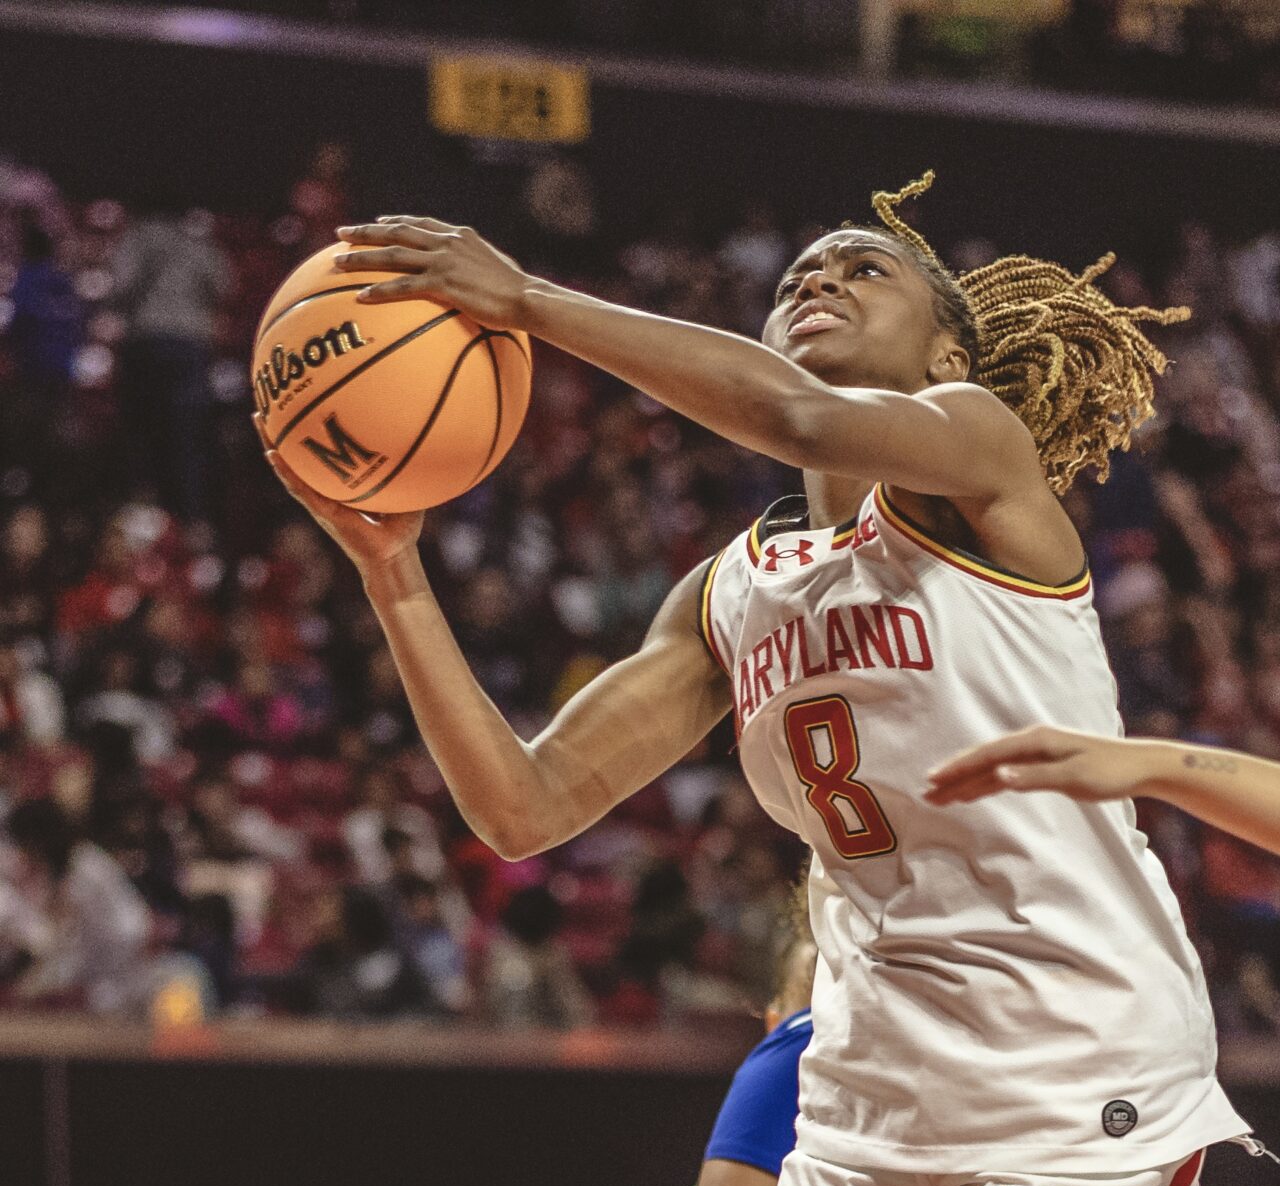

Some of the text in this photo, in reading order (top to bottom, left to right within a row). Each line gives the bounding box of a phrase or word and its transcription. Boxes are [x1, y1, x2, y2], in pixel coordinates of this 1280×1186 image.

[733, 604, 934, 748] ARYLAND
[784, 693, 898, 861] 8
[1111, 1111, 1129, 1121] MD
